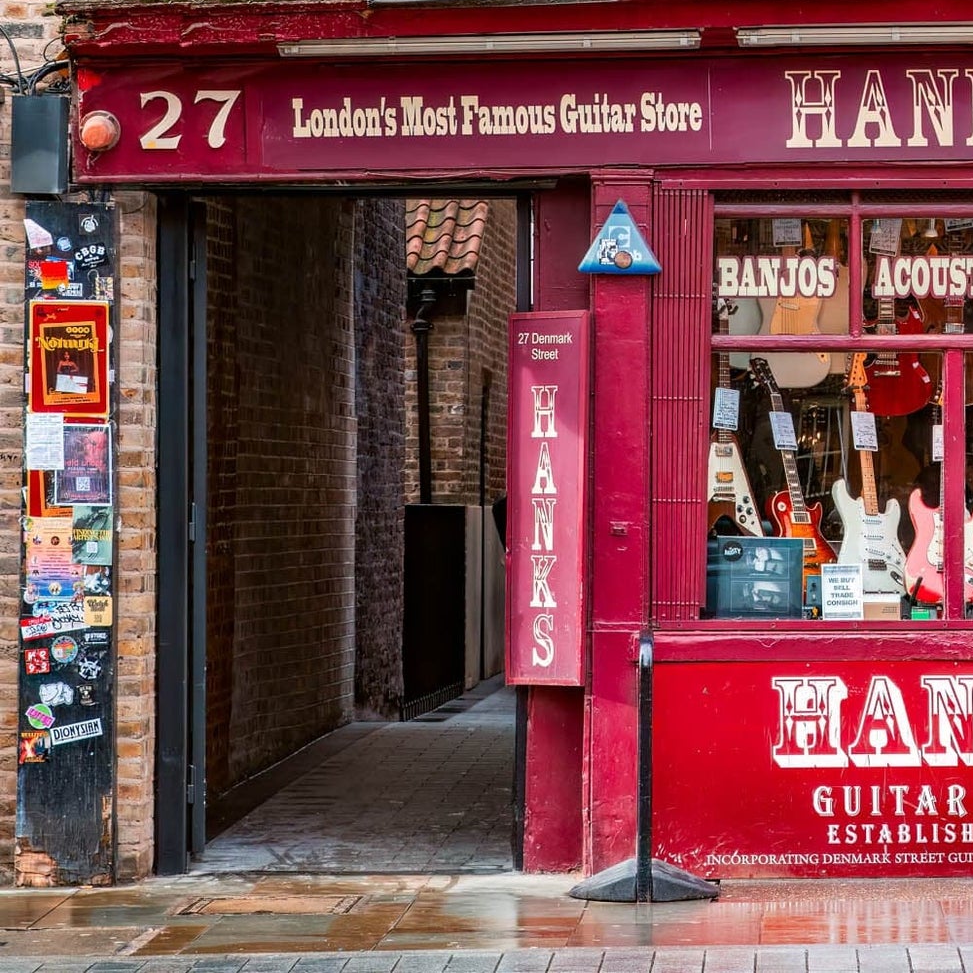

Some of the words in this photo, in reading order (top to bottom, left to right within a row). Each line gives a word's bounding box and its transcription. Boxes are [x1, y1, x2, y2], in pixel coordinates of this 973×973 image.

[139, 90, 242, 150] 27
[292, 96, 398, 139] London's
[400, 95, 459, 136] Most
[461, 94, 557, 135] Famous
[559, 92, 638, 134] Guitar
[640, 91, 703, 132] Store
[717, 256, 836, 297] BANJOS
[517, 332, 531, 345] 27
[532, 331, 573, 345] Denmark
[531, 348, 559, 361] Street
[531, 384, 557, 668] HANKS
[53, 719, 100, 740] DIONYSIAN
[812, 785, 967, 817] GUITAR
[706, 852, 819, 865] INCORPORATING
[822, 852, 891, 865] DENMARK
[894, 852, 945, 864] STREET
